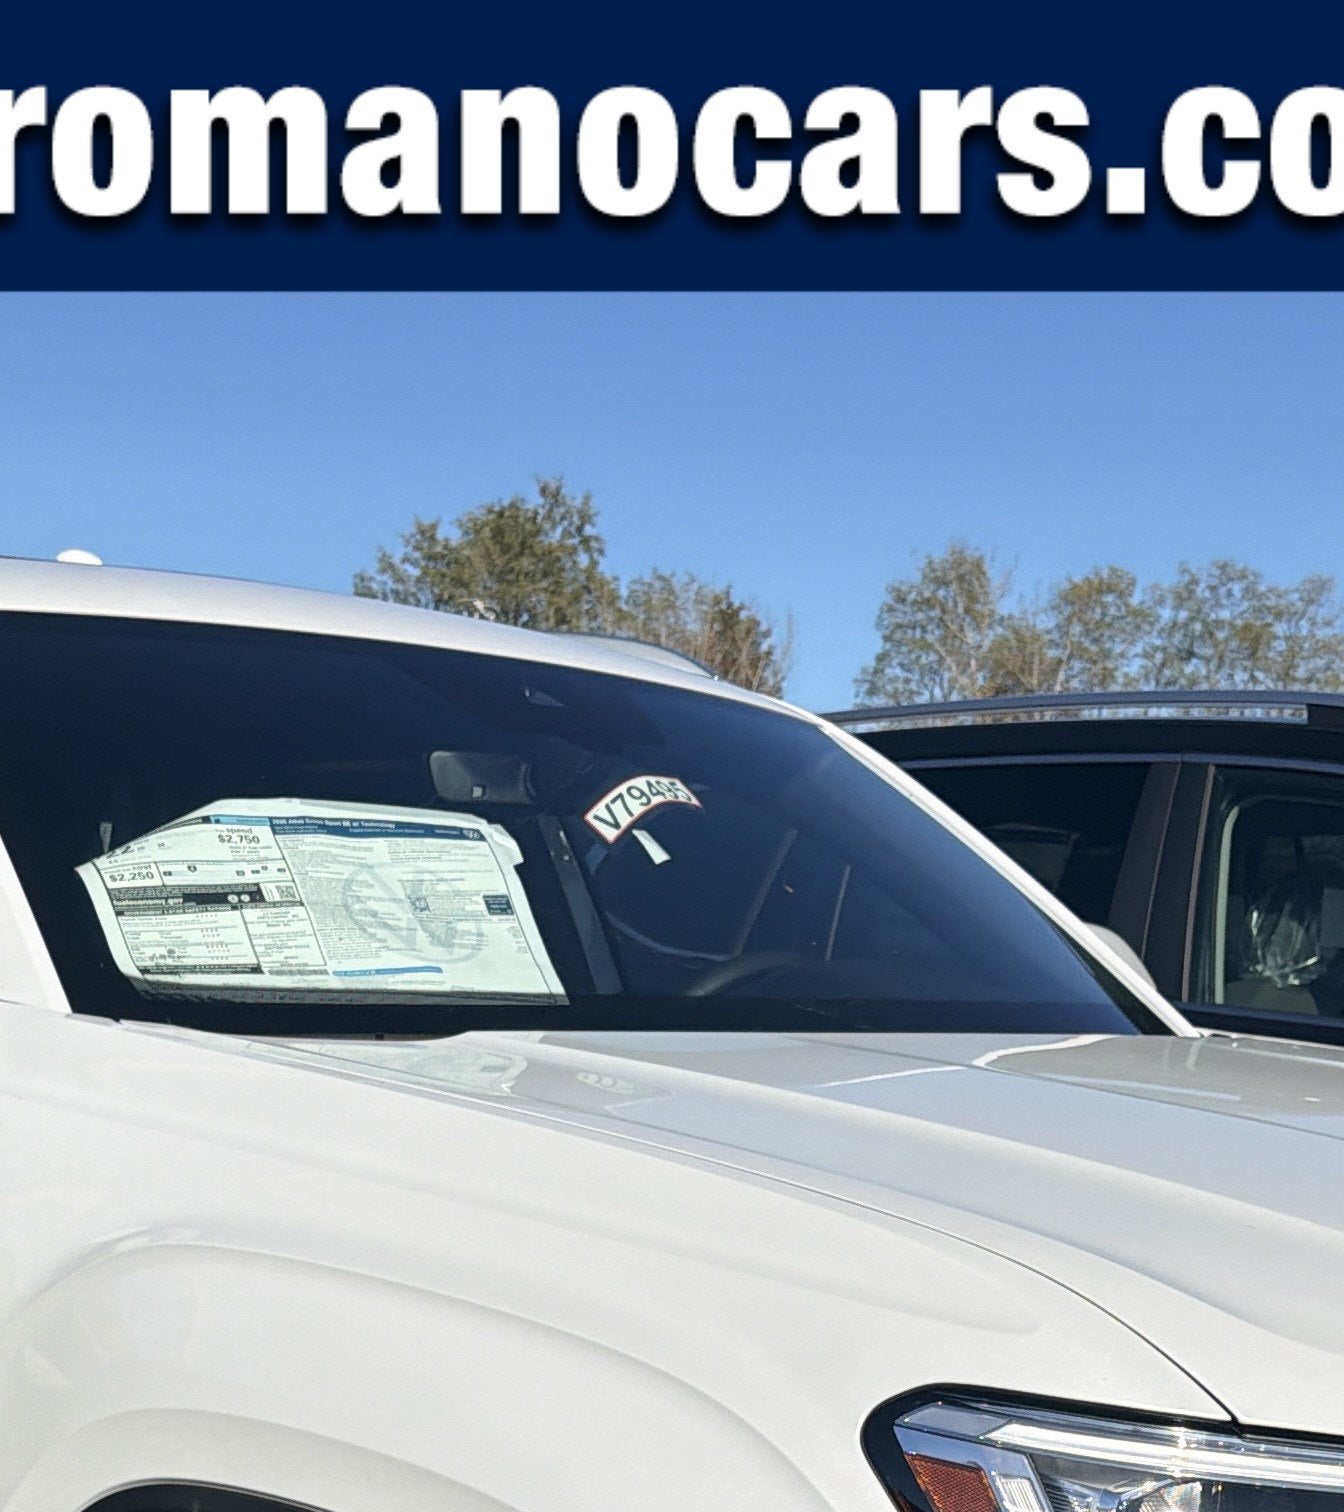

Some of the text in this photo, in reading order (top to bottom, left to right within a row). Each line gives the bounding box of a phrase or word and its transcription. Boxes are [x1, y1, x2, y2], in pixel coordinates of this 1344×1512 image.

[592, 779, 692, 830] V79495
[217, 834, 260, 845] $2,750
[108, 871, 155, 883] $2,250
